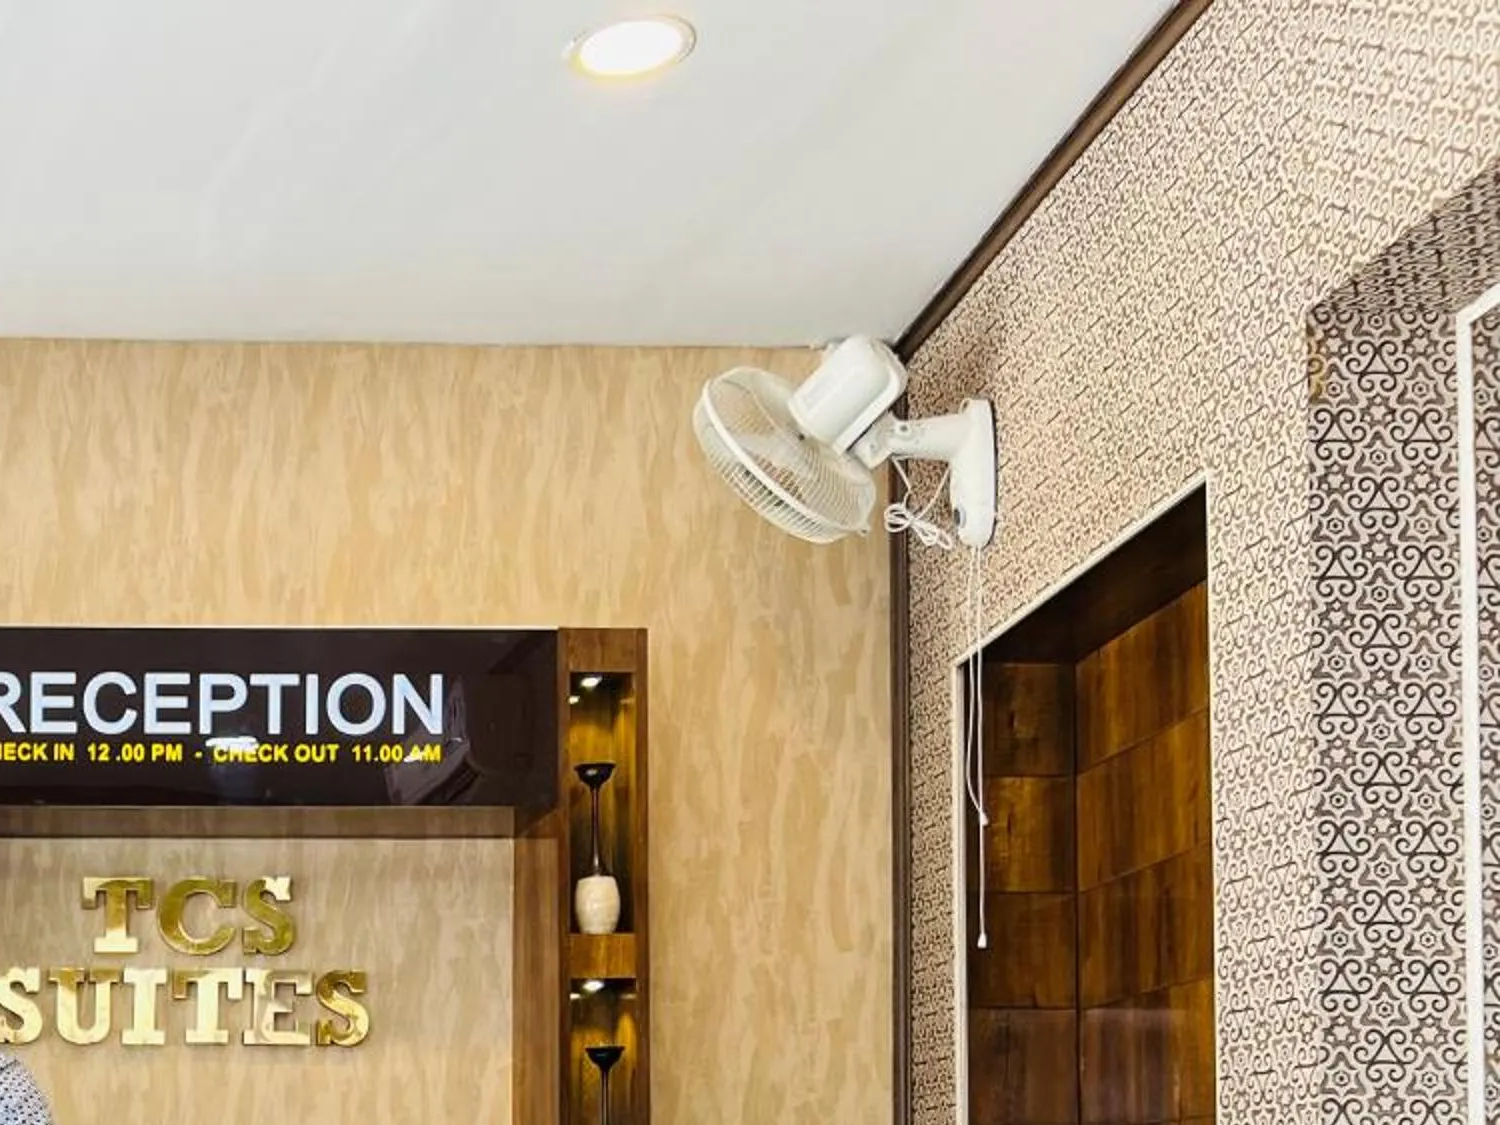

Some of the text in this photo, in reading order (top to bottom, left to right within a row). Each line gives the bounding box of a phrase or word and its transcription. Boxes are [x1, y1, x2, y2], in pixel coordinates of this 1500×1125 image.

[53, 743, 75, 761] IN
[87, 743, 110, 761] 12
[151, 743, 183, 761] PM
[213, 742, 289, 763] CHECK
[294, 743, 340, 763] OUT
[351, 743, 404, 763] 11.00
[408, 743, 442, 763] AM
[81, 876, 296, 957] TCS
